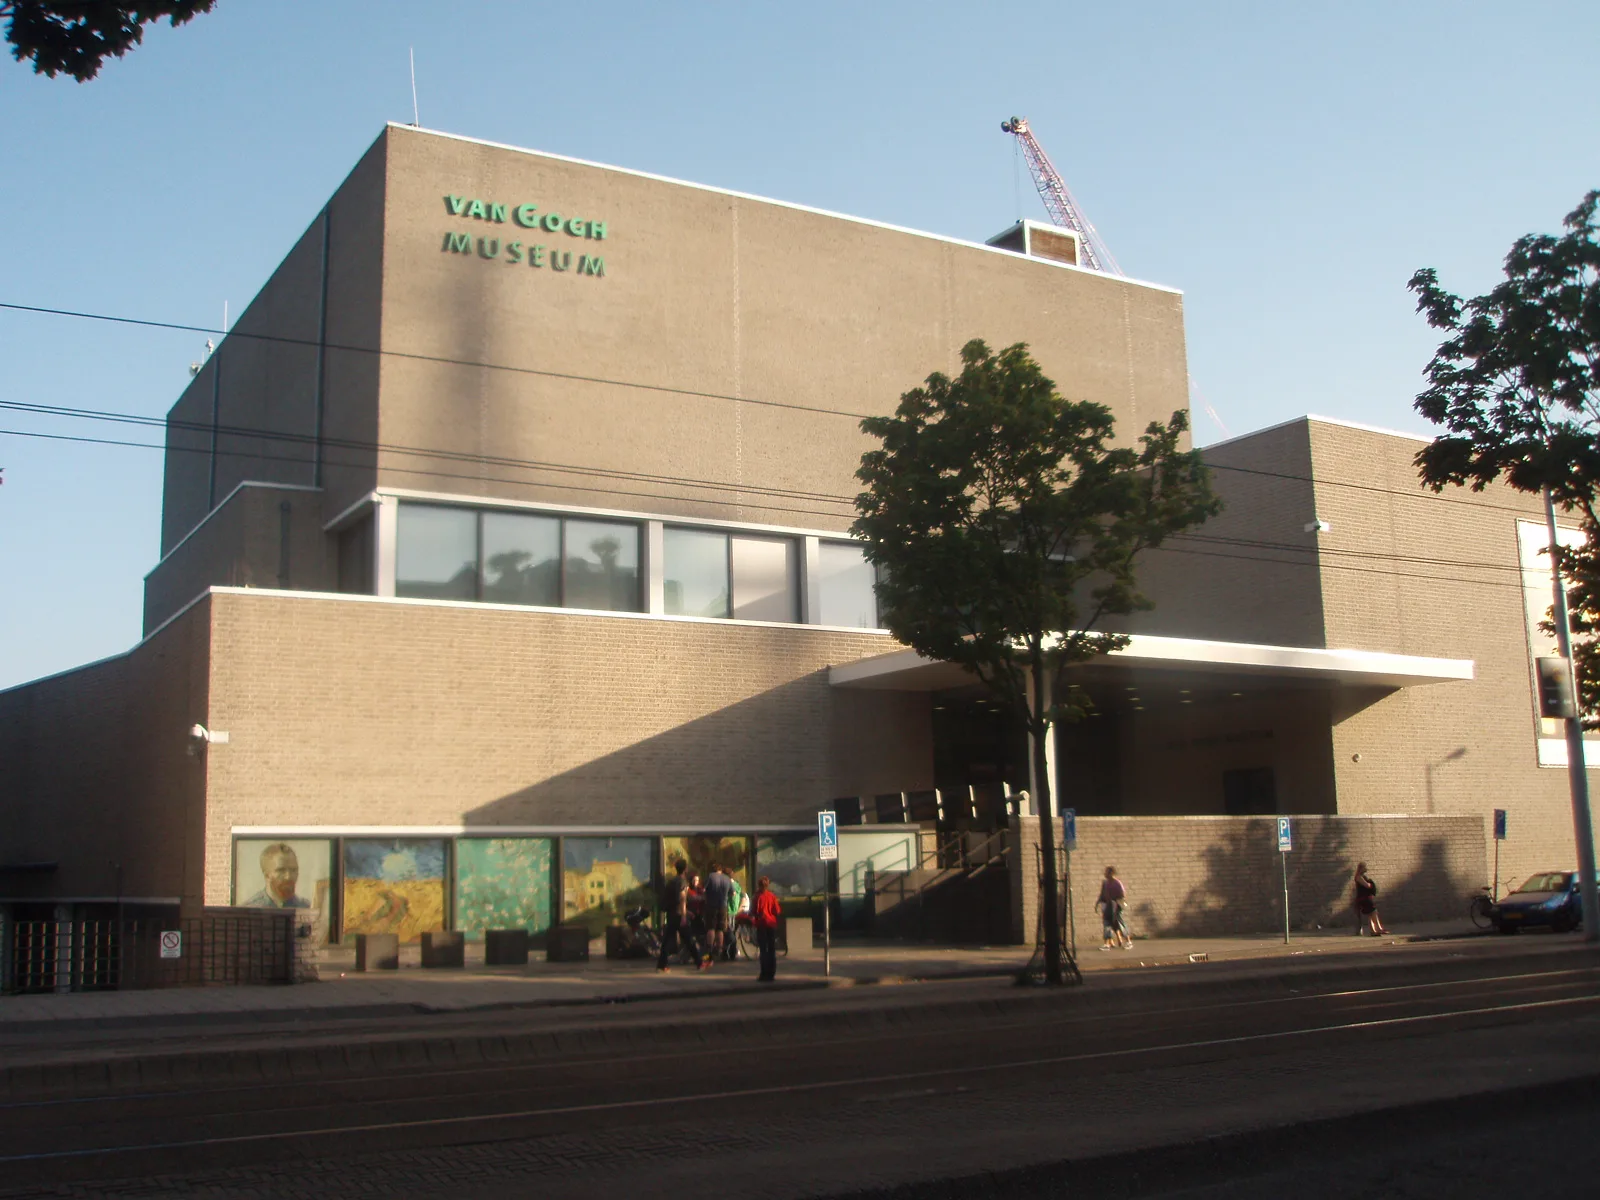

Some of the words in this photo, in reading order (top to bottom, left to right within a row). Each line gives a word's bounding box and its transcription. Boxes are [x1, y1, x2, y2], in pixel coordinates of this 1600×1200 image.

[445, 194, 508, 223] VAN
[514, 203, 608, 240] GOGH
[443, 231, 606, 277] MUSEUM
[822, 815, 833, 833] P
[1280, 819, 1287, 835] P
